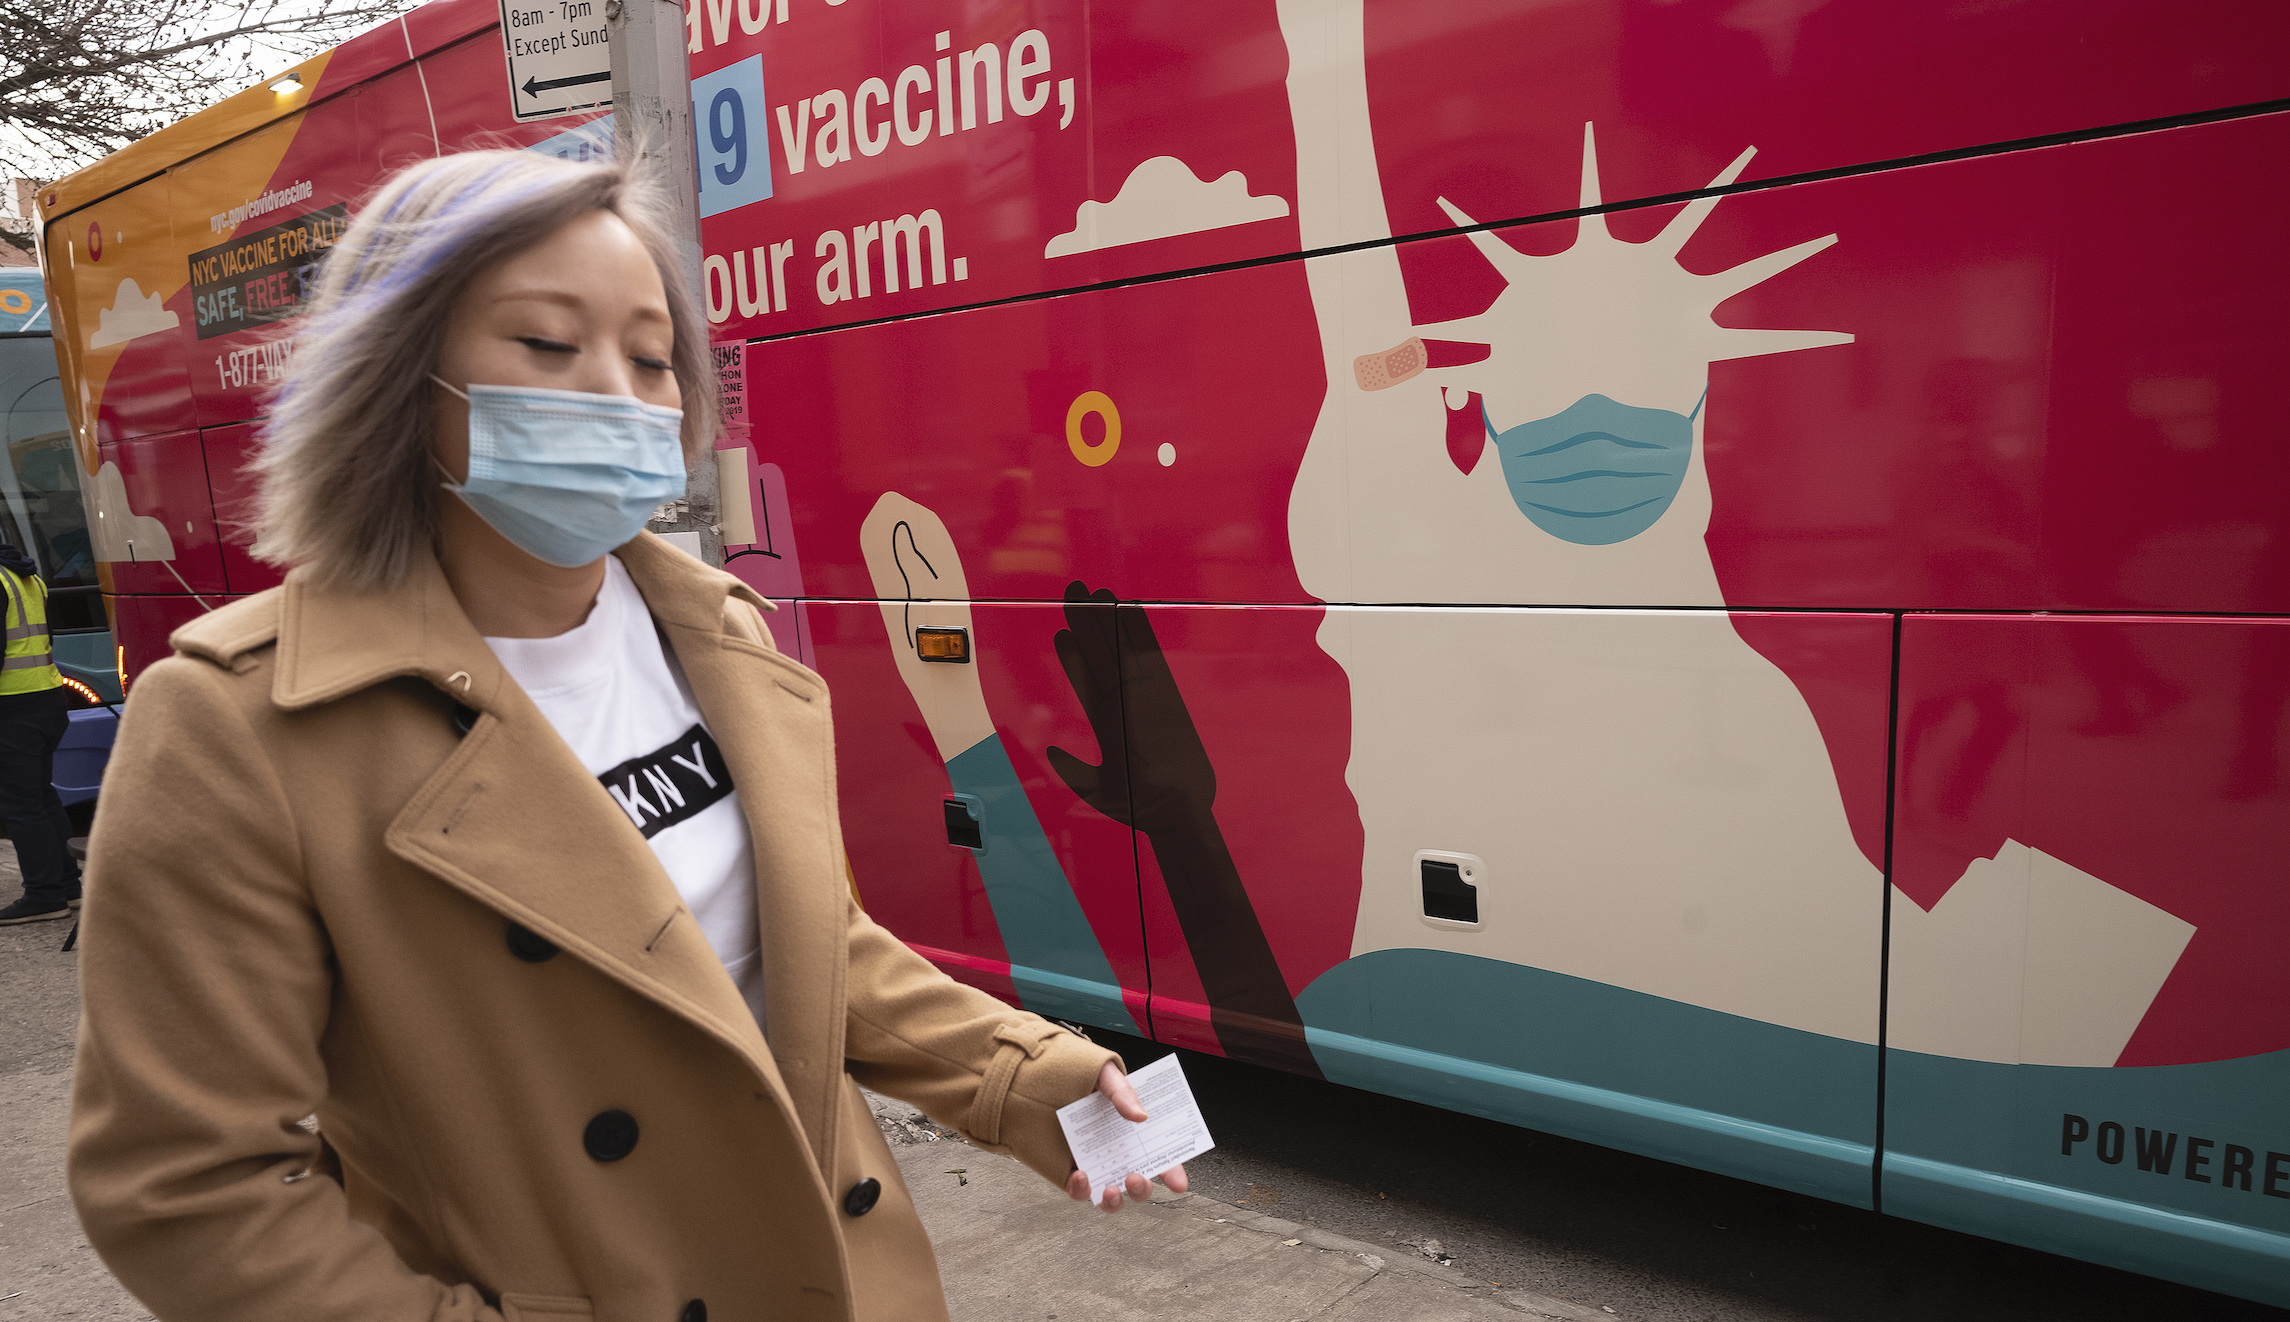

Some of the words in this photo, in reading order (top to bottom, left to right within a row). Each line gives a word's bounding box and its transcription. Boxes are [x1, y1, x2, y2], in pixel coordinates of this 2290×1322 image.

[511, 9, 544, 28] 8am
[559, 1, 592, 23] 7pm
[514, 31, 567, 57] Except
[571, 24, 609, 48] Sund
[775, 28, 1076, 175] vaccine,
[210, 179, 313, 234] nyc.gov/covidvaccine
[192, 256, 220, 287] NYC
[219, 235, 277, 277] VACCINE
[278, 226, 309, 261] FOR
[702, 239, 795, 325] our
[814, 208, 968, 306] arm.
[196, 286, 244, 326] SAFE,
[245, 271, 296, 314] FREE,
[214, 339, 293, 390] 1-877-VAX
[721, 369, 741, 381] HON
[607, 740, 719, 829] KNY
[2061, 1113, 2290, 1200] POWERE
